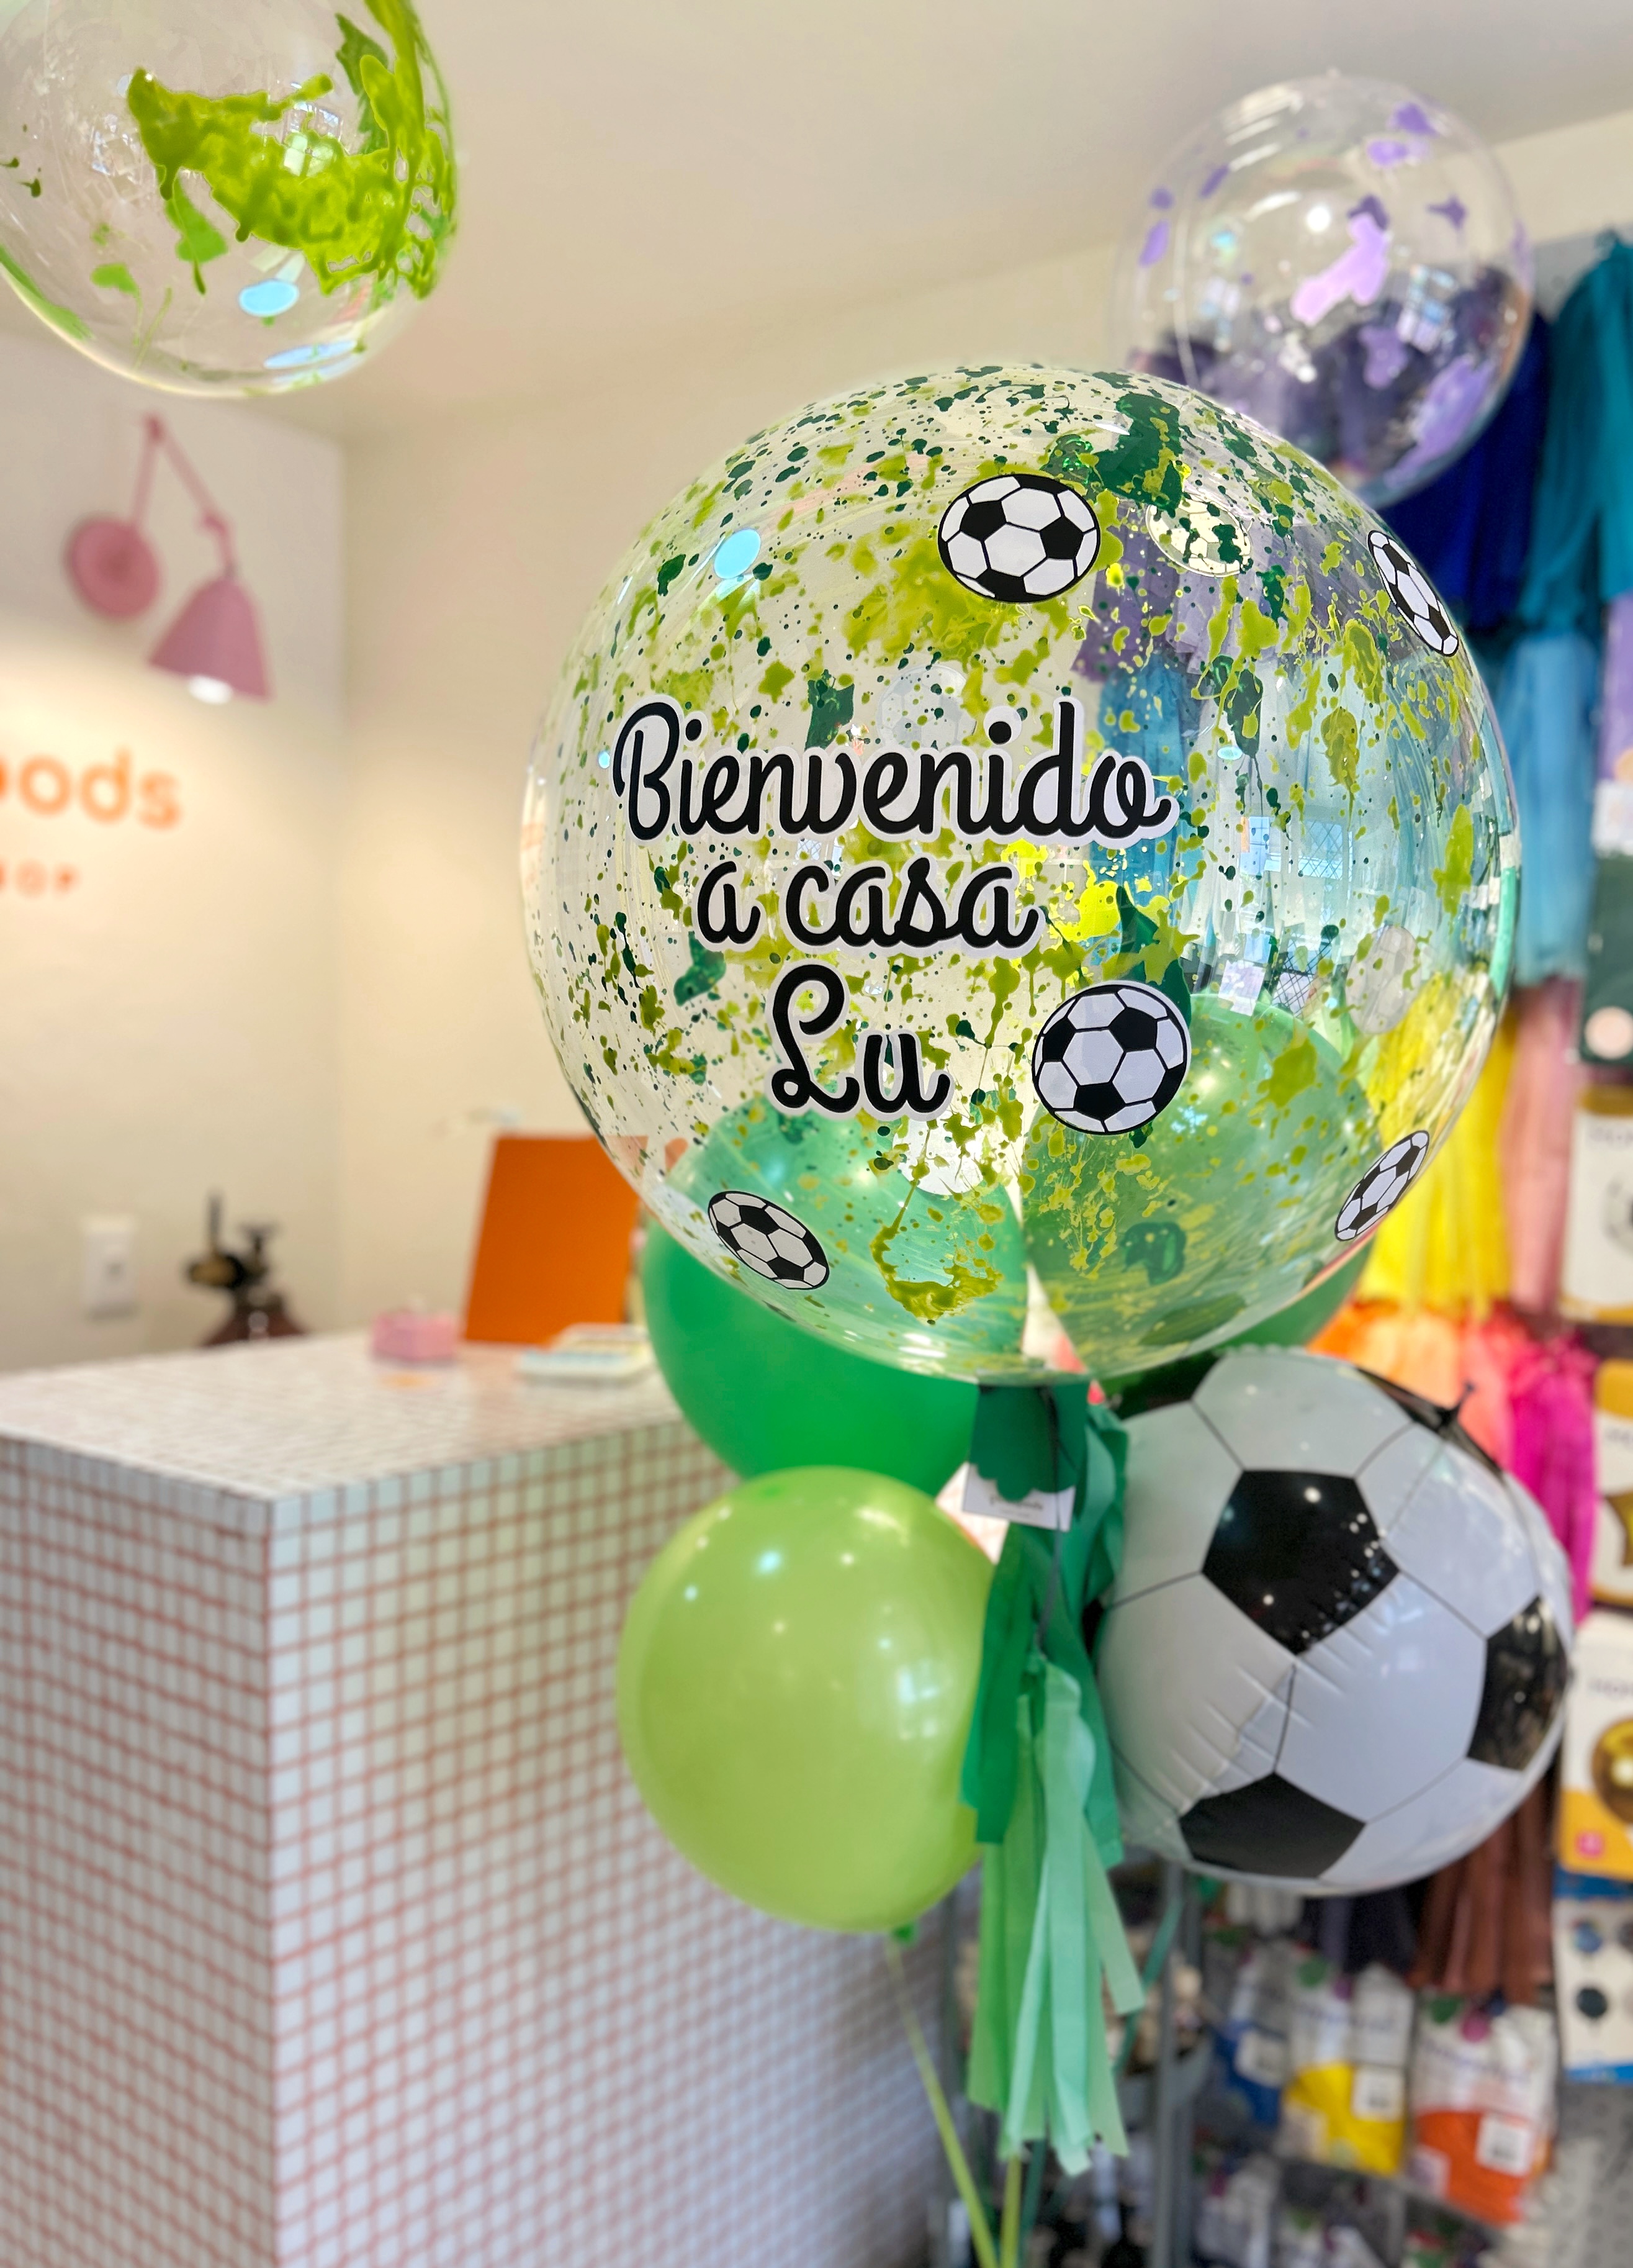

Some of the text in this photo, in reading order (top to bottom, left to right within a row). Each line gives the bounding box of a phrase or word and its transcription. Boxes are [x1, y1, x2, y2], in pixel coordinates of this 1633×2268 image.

[0, 745, 183, 831] ods
[613, 701, 1171, 841] Bienvenido
[698, 857, 1039, 949] a casa
[771, 964, 950, 1114] Lu
